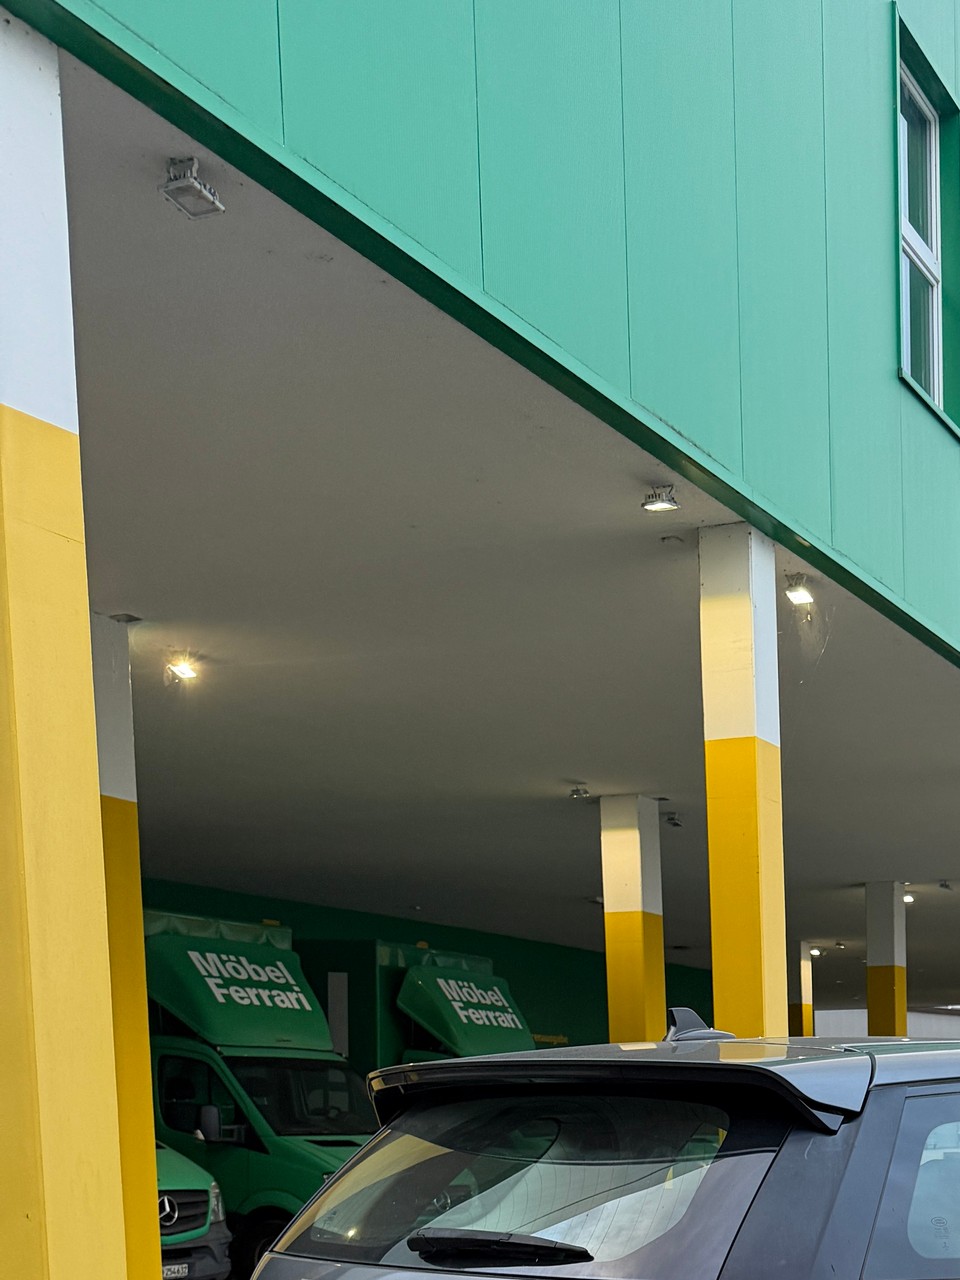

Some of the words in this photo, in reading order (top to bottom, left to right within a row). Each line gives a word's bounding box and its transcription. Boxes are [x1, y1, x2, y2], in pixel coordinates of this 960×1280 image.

[187, 950, 297, 985] Möbel
[204, 977, 312, 1011] Ferrari
[436, 978, 510, 1008] Möbel
[451, 1001, 523, 1029] Ferrari
